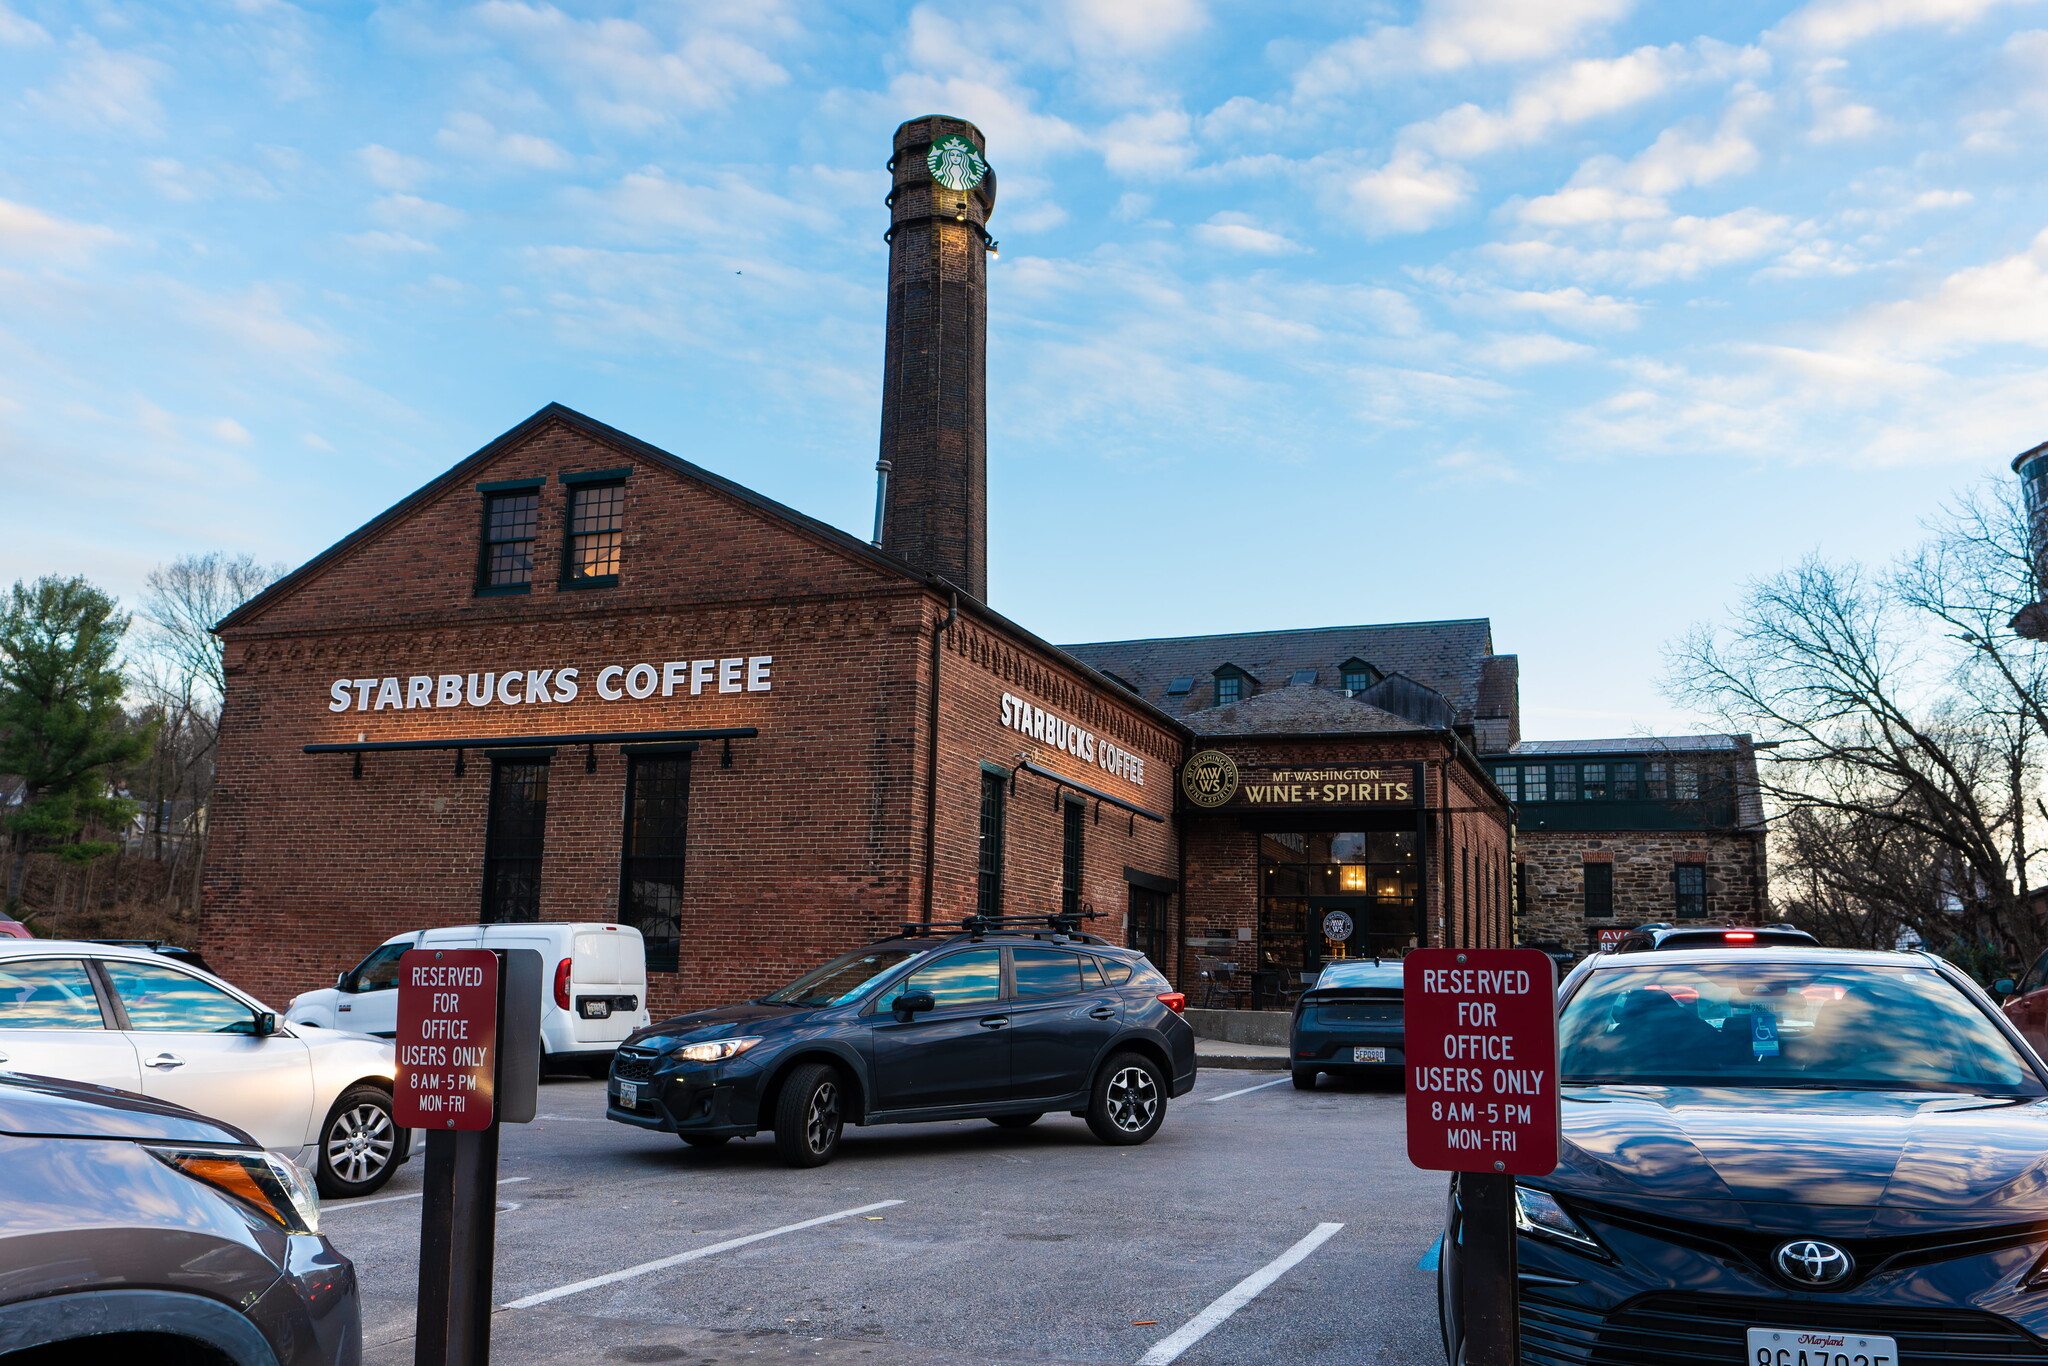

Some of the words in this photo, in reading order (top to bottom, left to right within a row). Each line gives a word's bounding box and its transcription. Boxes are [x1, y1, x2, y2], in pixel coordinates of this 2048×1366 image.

[329, 668, 579, 712] STARBUCKS
[597, 656, 773, 700] COFFEE
[1001, 692, 1094, 762] STARBUCKS
[1099, 740, 1144, 786] COFFEE
[1196, 767, 1222, 780] MW
[1199, 780, 1220, 792] WS
[412, 967, 483, 986] RESERVED
[1424, 970, 1530, 994] RESERVED
[433, 993, 459, 1013] FOR
[1458, 1002, 1497, 1027] FOR
[421, 1019, 469, 1040] OFFICE
[402, 1046, 446, 1066] USERS
[452, 1047, 487, 1067] ONLY
[1443, 1034, 1515, 1061] OFFICE
[410, 1073, 418, 1089] 8
[458, 1075, 477, 1091] PM
[1415, 1067, 1484, 1093] USERS
[1493, 1069, 1544, 1095] ONLY
[419, 1095, 465, 1112] MON-FRI
[1431, 1101, 1443, 1121] 8
[1505, 1105, 1532, 1125] PM
[1447, 1128, 1517, 1152] MON-FRI
[1797, 1334, 1845, 1349] Maryland
